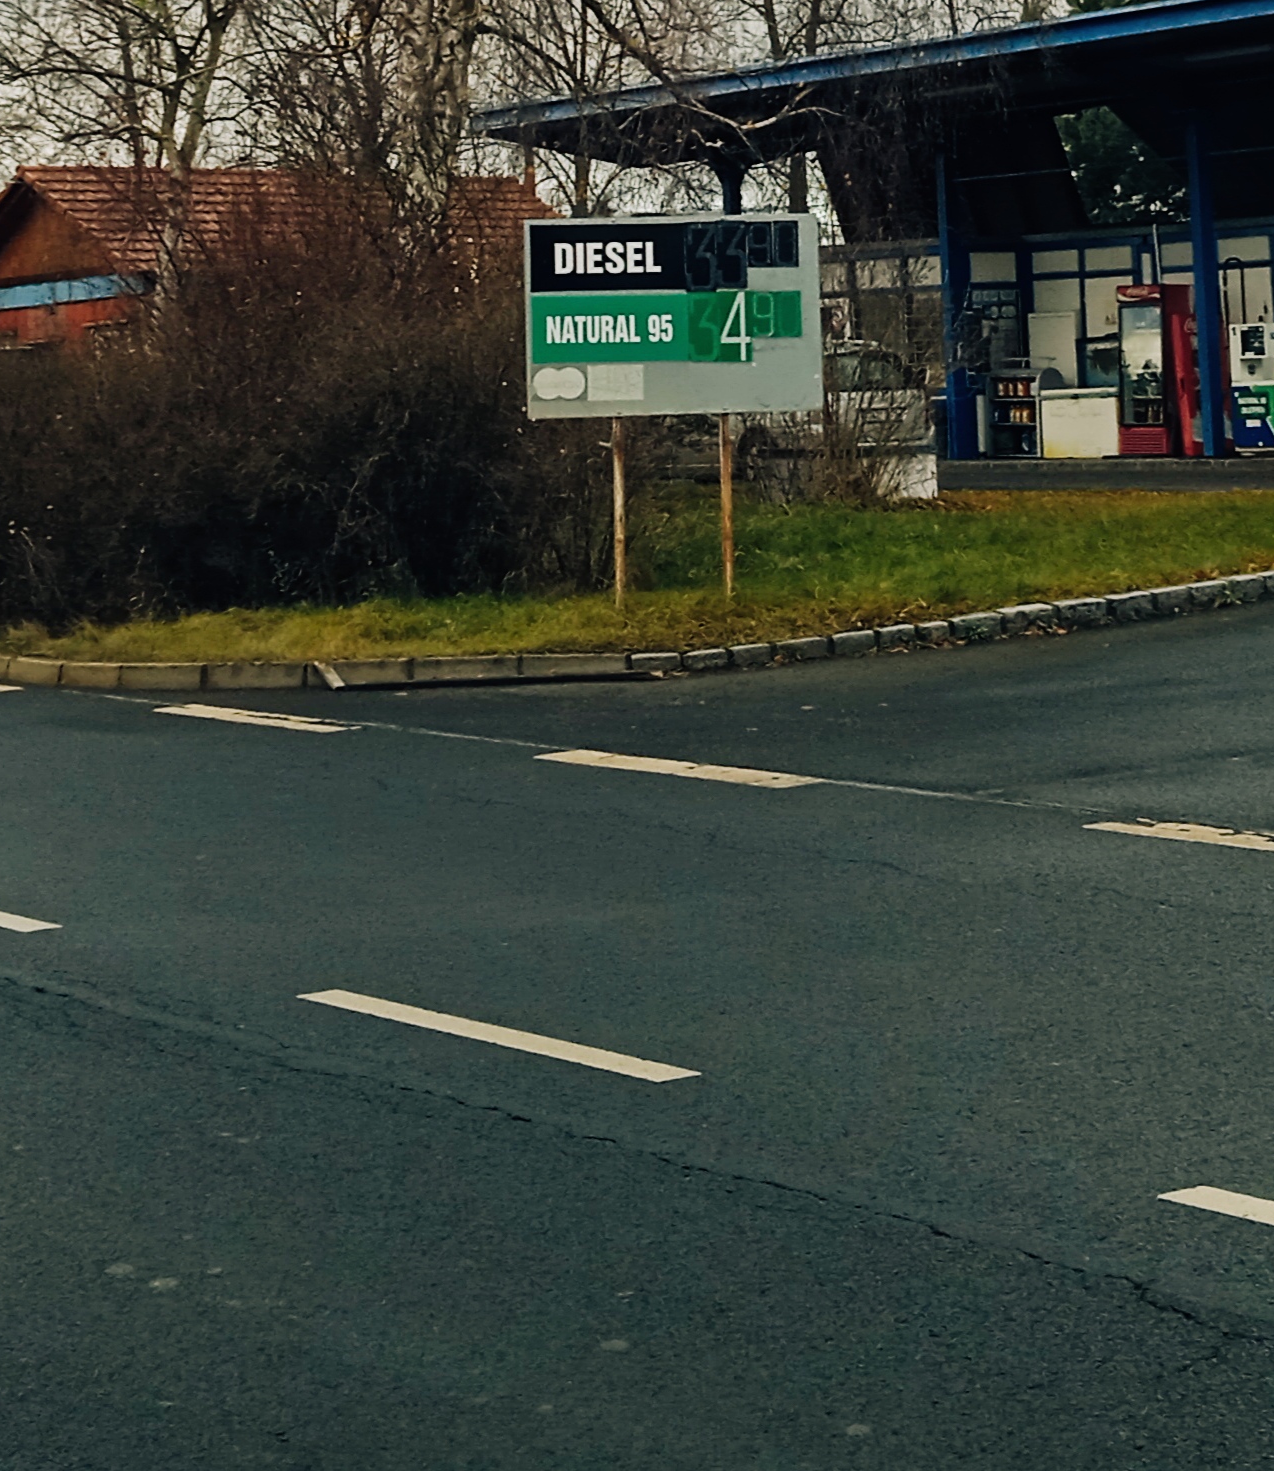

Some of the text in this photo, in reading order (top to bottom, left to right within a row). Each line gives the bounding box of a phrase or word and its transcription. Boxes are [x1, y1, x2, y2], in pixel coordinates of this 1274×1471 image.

[553, 241, 662, 275] DIESEL
[545, 314, 641, 345] NATURAL
[647, 314, 674, 343] 95
